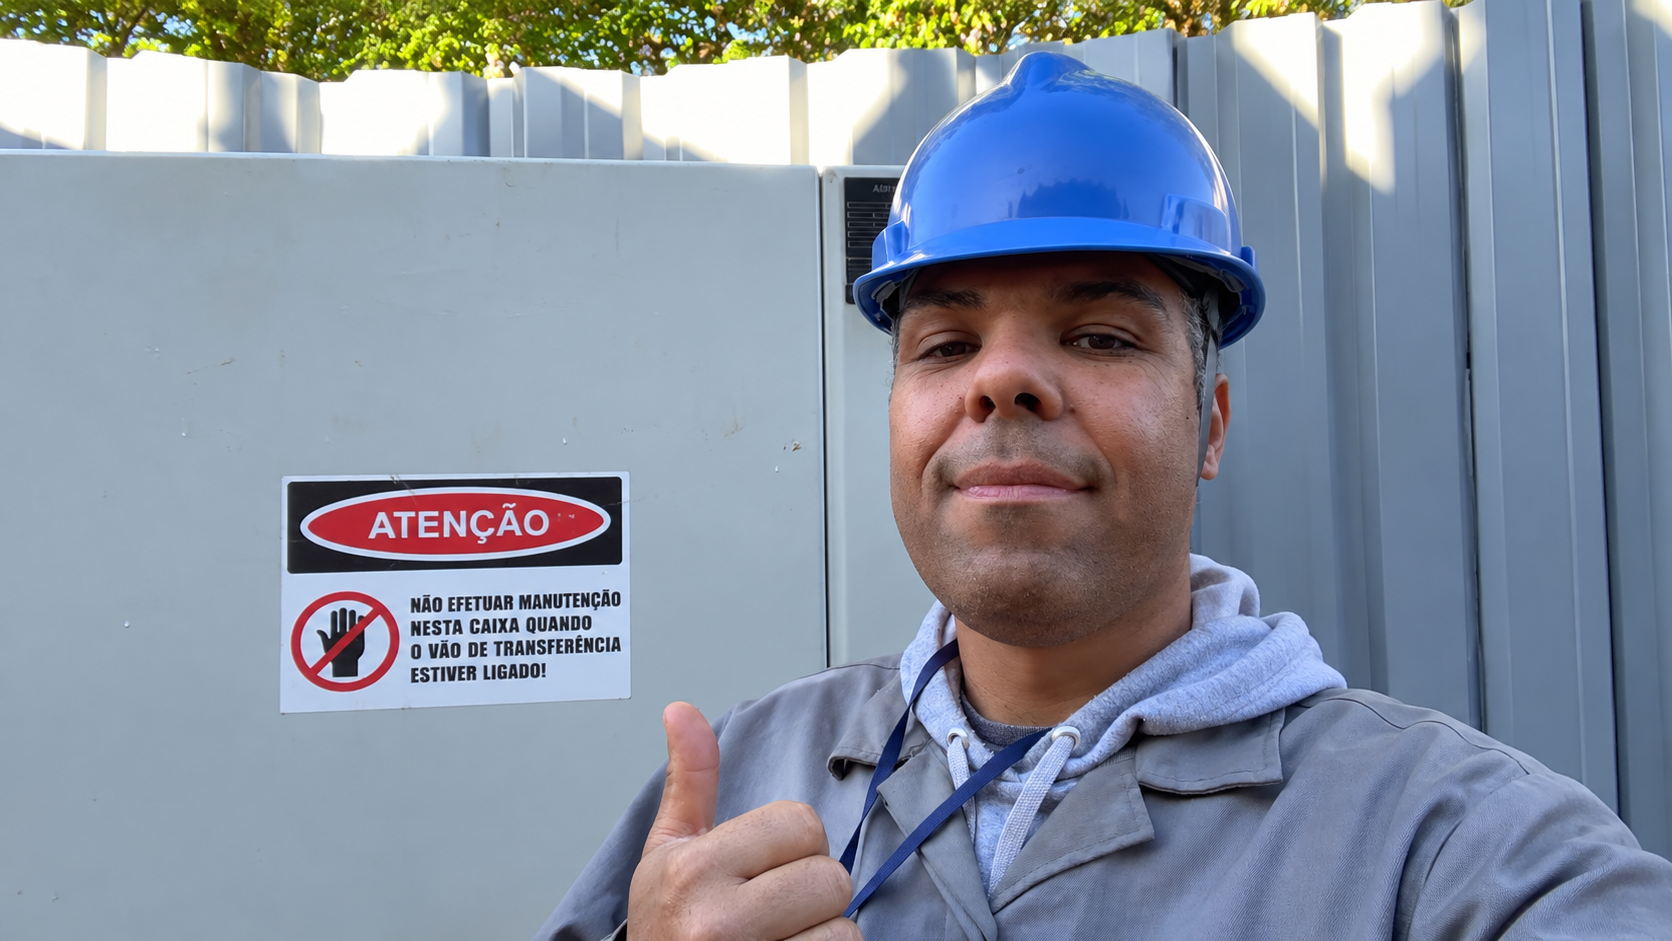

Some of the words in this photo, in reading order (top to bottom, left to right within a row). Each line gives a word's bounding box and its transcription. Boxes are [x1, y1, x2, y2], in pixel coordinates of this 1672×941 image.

[368, 503, 549, 544] ATENÇÃO
[410, 594, 442, 613] NÃO
[448, 595, 513, 612] EFETUAR
[519, 589, 621, 611] MANUTENÇÃO
[411, 620, 463, 636] NESTA
[470, 618, 519, 634] CAIXA
[526, 615, 592, 632] QUANDO
[411, 644, 421, 659] O
[429, 639, 460, 659] VÃO
[469, 642, 487, 657] DE
[494, 635, 621, 656] TRANSFERÊNCIA
[411, 665, 476, 683] ESTIVER
[483, 663, 546, 681] LIGADO!
